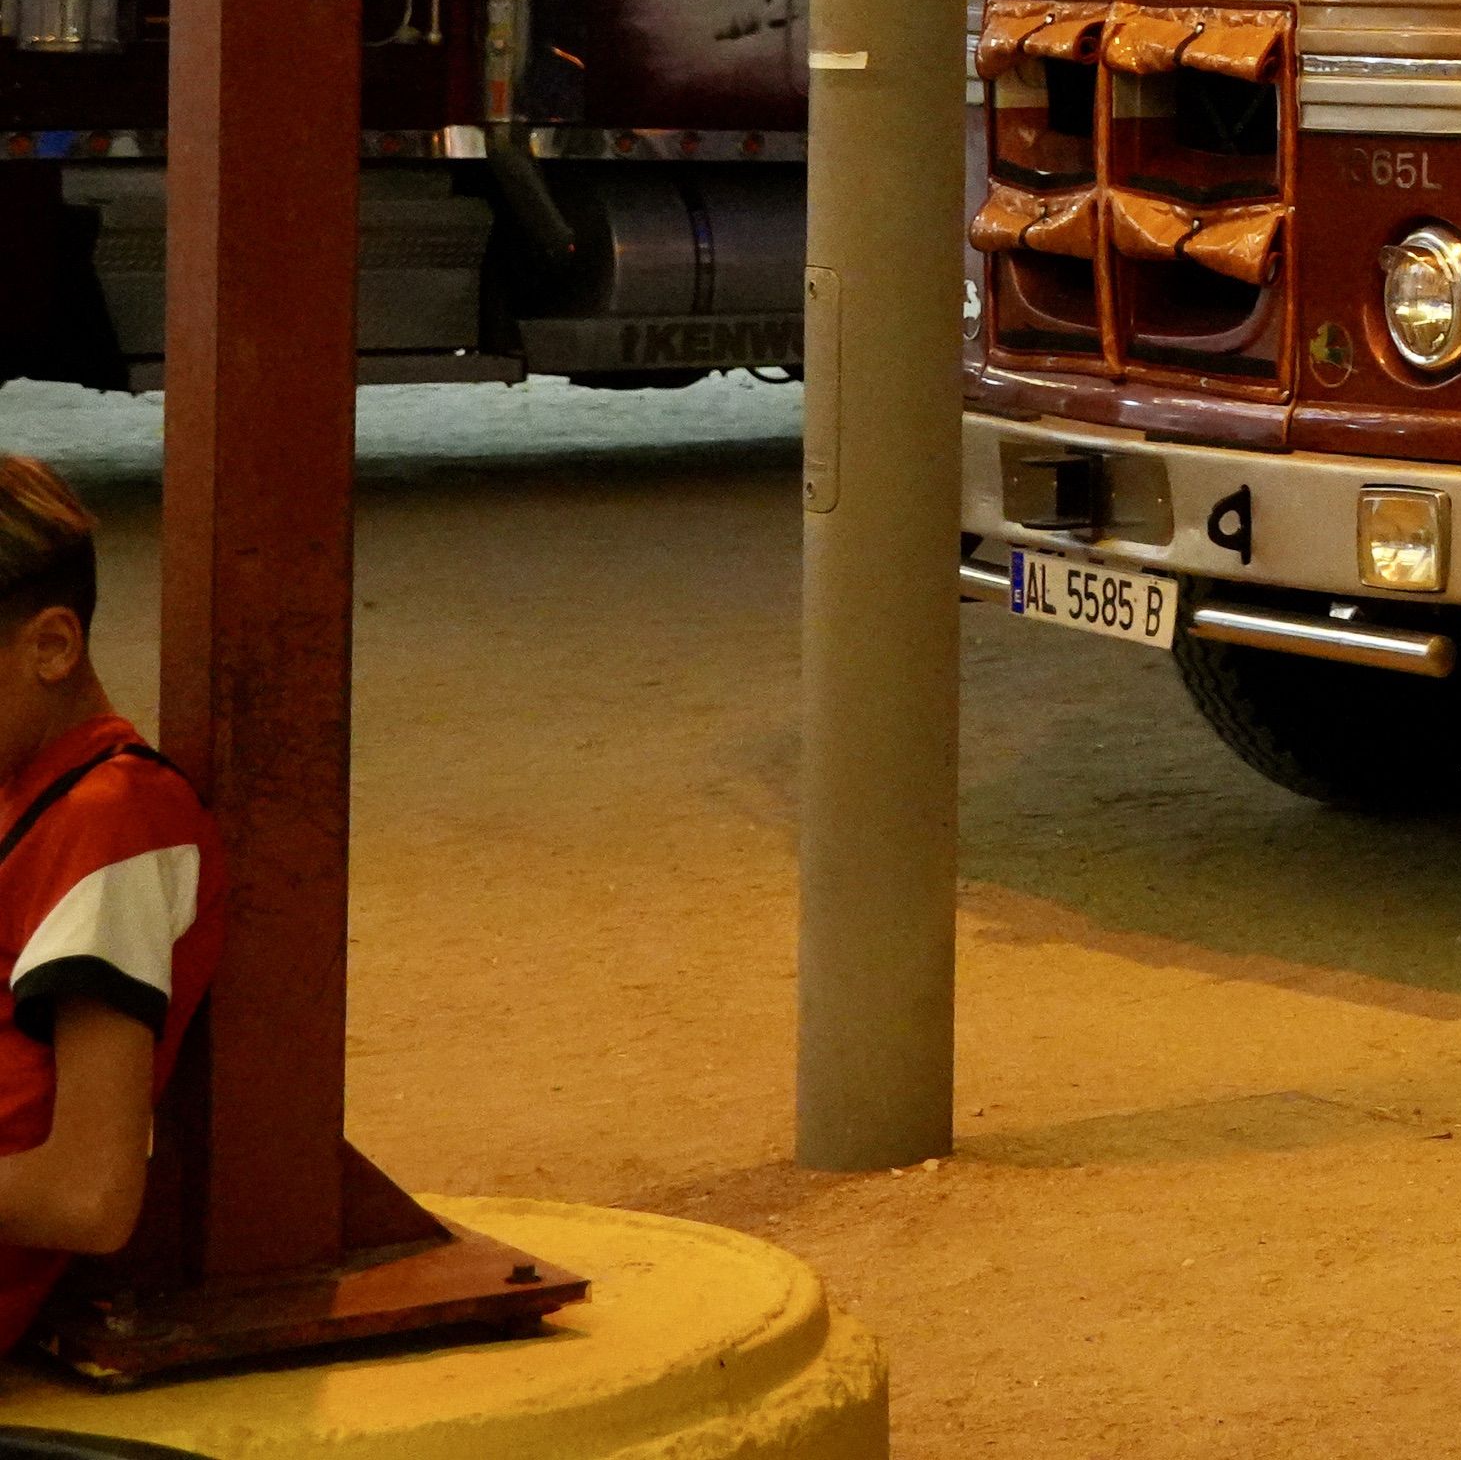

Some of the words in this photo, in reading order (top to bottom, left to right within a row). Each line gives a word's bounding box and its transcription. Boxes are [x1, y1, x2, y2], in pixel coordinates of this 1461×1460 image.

[645, 321, 804, 362] KENW
[1026, 562, 1056, 615] AL
[1067, 569, 1134, 631] 5585
[1145, 585, 1163, 637] B
